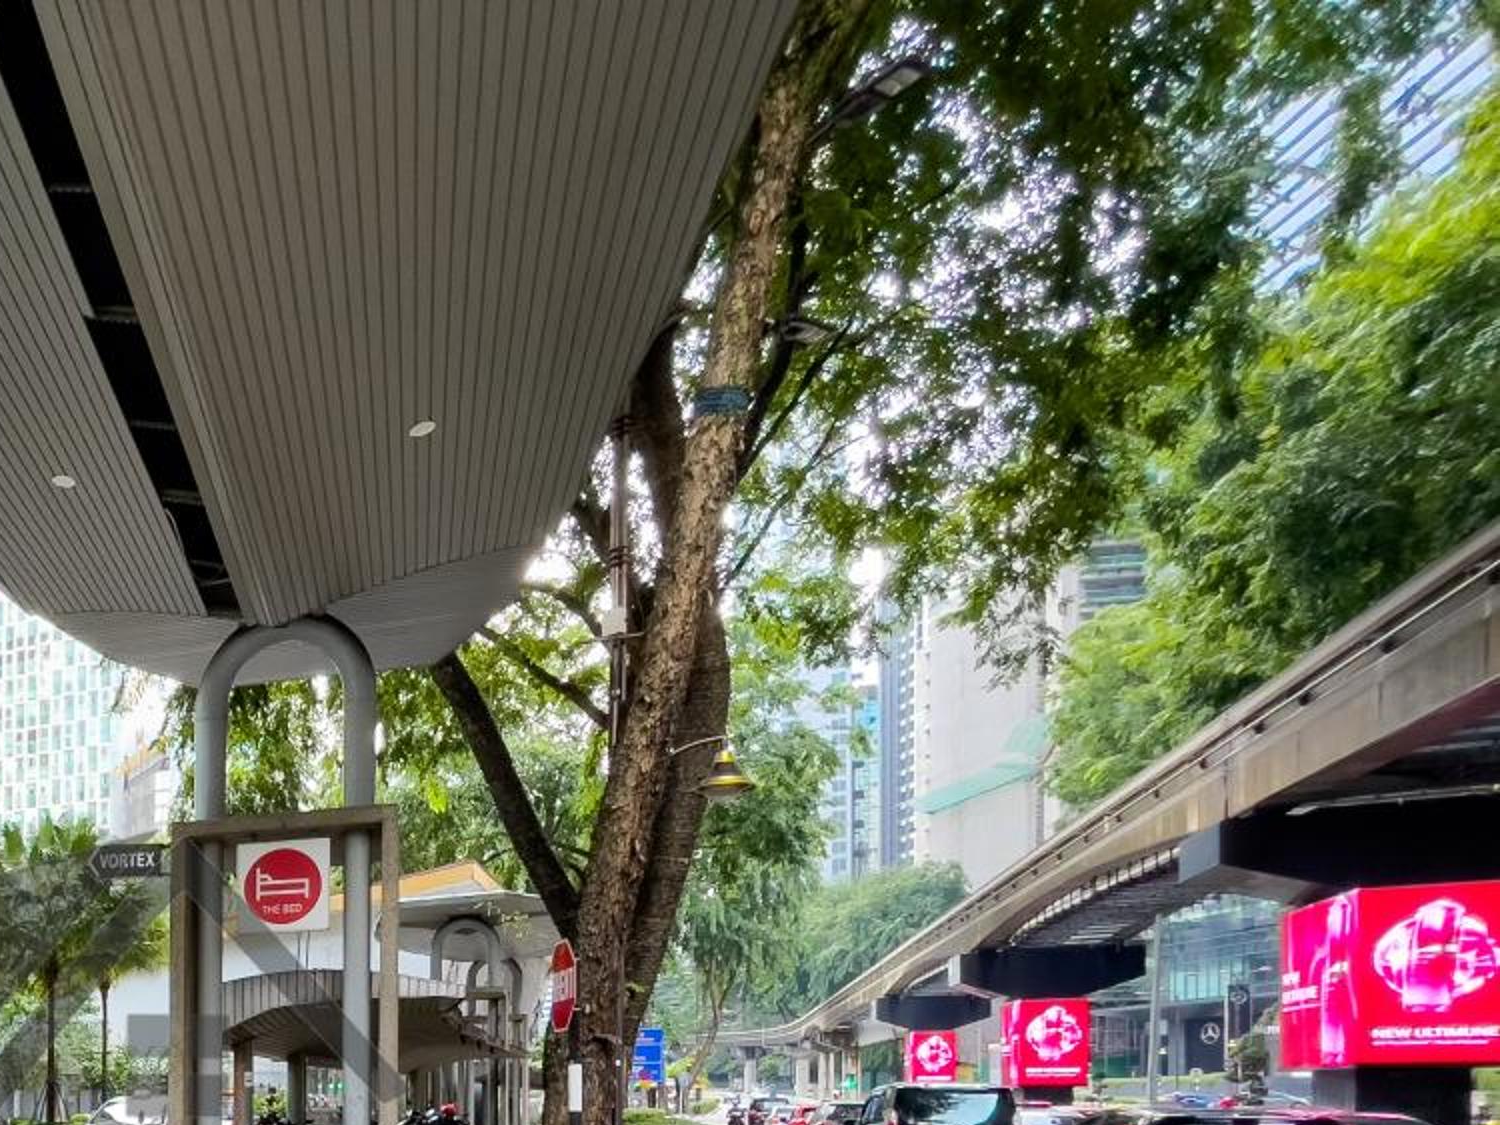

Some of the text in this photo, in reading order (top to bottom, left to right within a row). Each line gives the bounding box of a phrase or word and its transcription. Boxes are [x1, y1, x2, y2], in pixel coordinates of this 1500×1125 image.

[99, 851, 155, 868] VORTEX
[262, 903, 303, 914] THE BED
